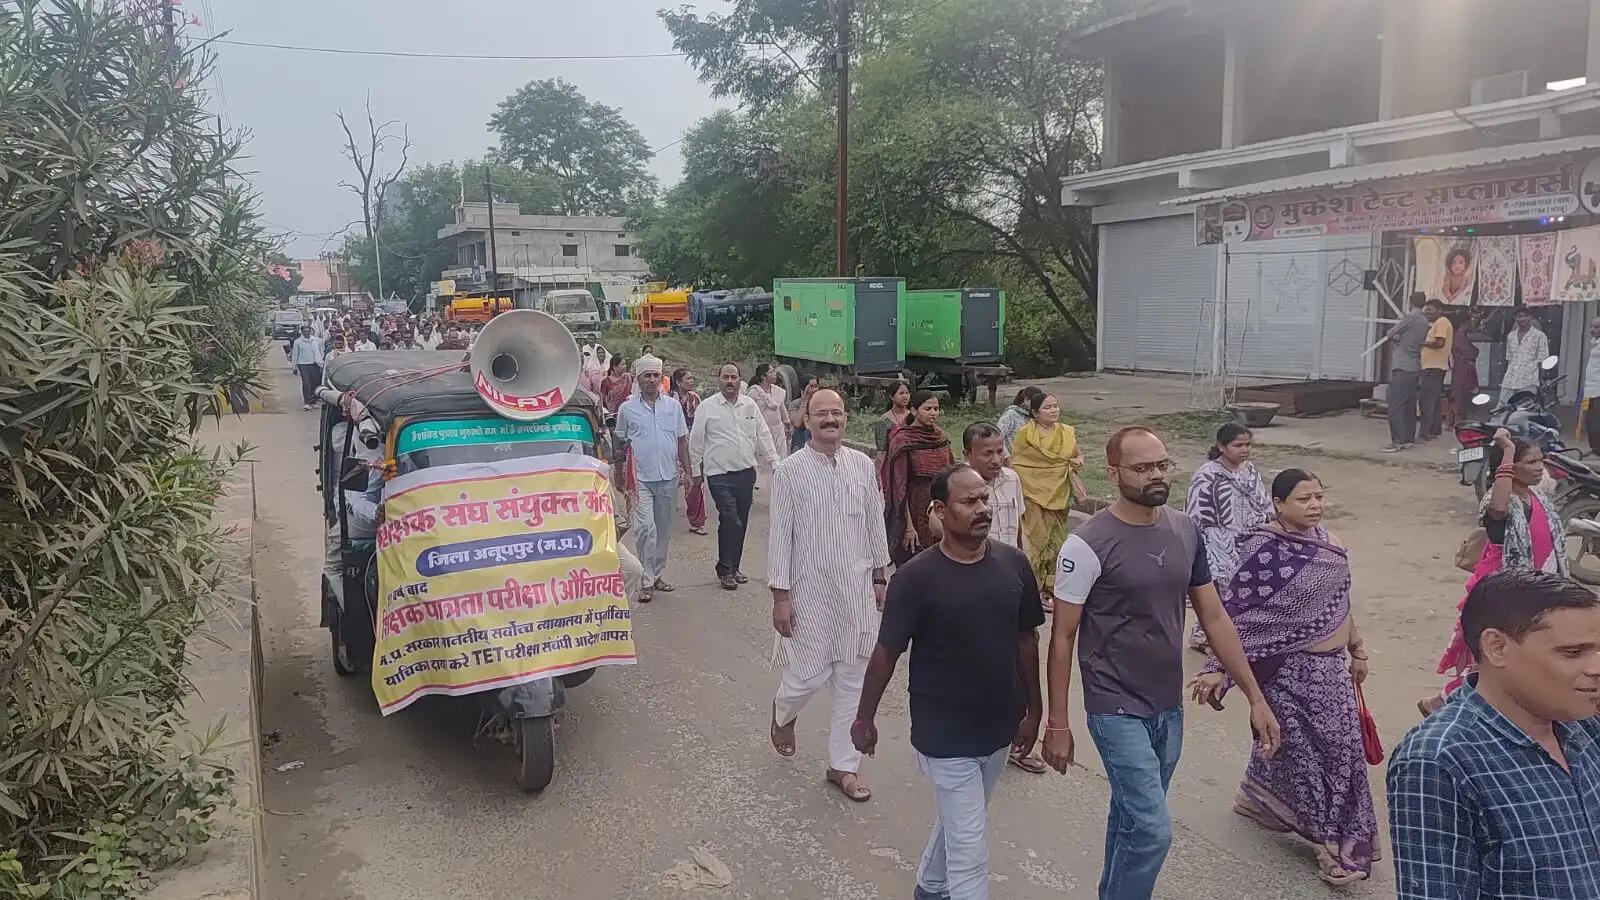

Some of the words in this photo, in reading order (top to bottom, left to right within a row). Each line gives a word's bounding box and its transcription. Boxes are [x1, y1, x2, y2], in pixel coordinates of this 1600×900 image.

[1280, 195, 1354, 225] मुकेश
[1361, 187, 1414, 211] टेन्ट
[478, 373, 557, 408] NILAY
[440, 492, 489, 527] संघ
[494, 487, 580, 527] संयुक्त
[427, 550, 470, 569] जिला
[473, 541, 534, 562] अनूपपुर
[537, 535, 584, 554] (म.प्र.)
[405, 582, 429, 596] बाद
[487, 577, 547, 610] परीक्षा
[490, 621, 534, 639] सर्वोच्च
[537, 614, 582, 631] न्यायालय
[584, 609, 594, 624] में
[384, 659, 430, 686] याचिका
[471, 647, 504, 666] TET
[504, 642, 540, 660] परीक्षा
[600, 630, 628, 642] वापस
